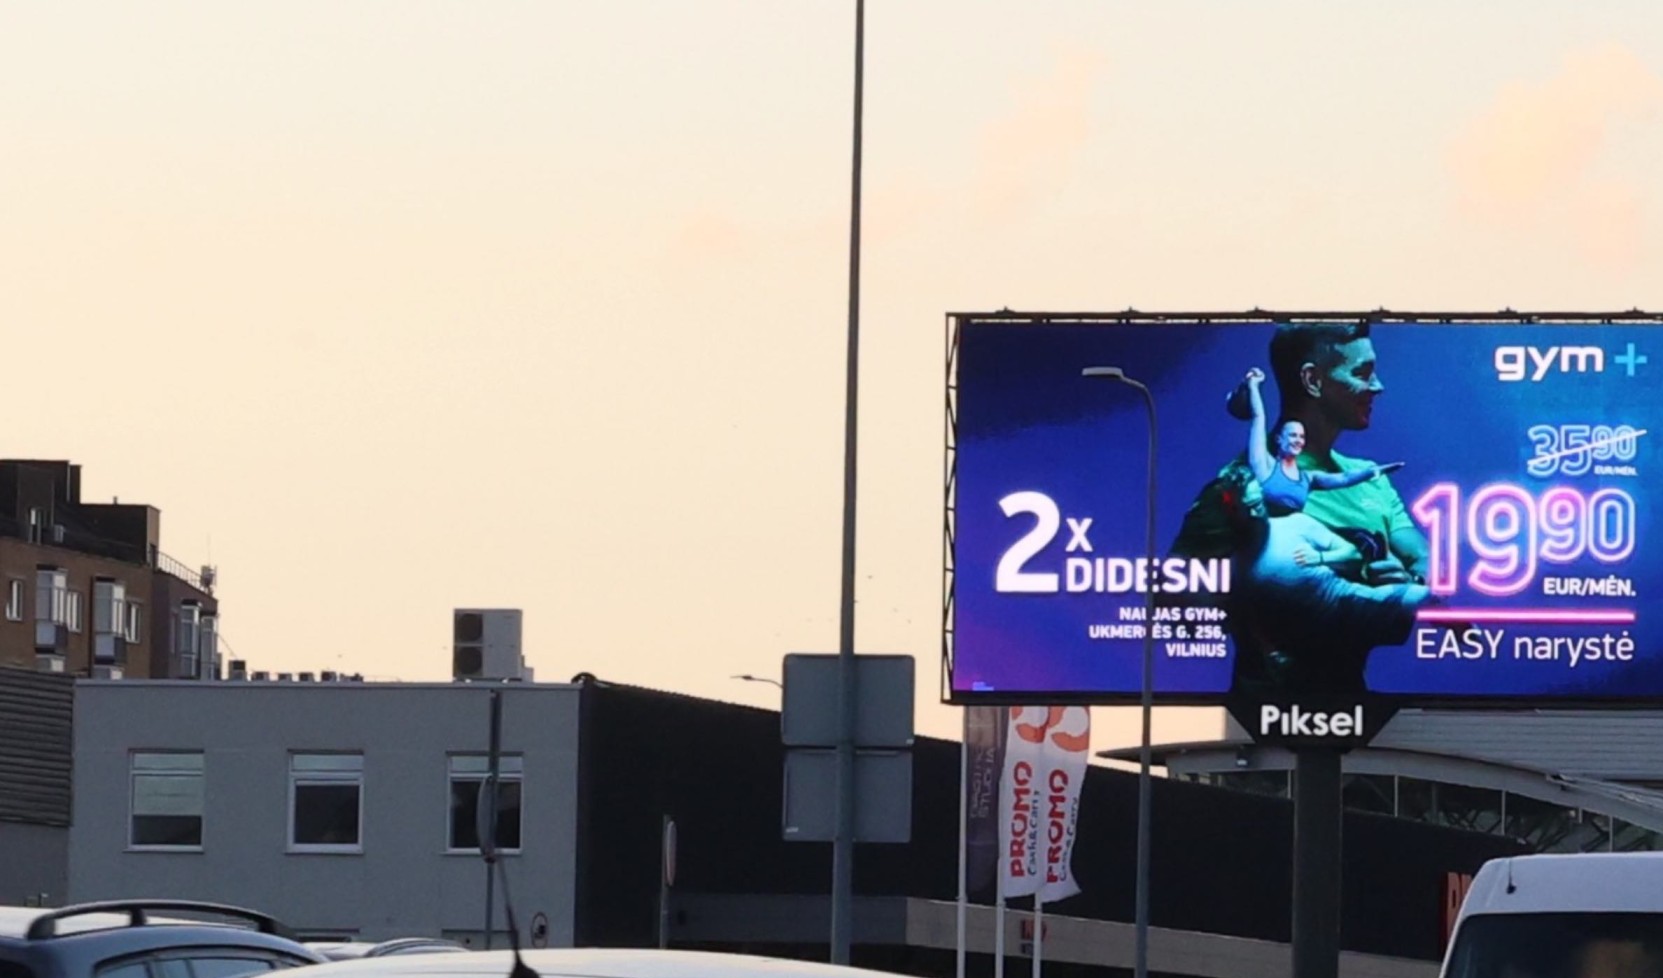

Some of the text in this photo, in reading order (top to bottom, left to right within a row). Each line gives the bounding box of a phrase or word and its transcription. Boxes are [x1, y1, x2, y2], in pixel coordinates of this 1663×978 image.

[1066, 557, 1231, 593] DIDESNI
[1543, 575, 1636, 597] EUR/MĖN.
[1165, 643, 1227, 657] VILNIUS
[1176, 625, 1191, 639] G.
[1195, 625, 1227, 642] 256,
[1417, 629, 1634, 667] EASY narystė
[1010, 761, 1032, 878] PROMO
[1046, 769, 1069, 883] PROMO
